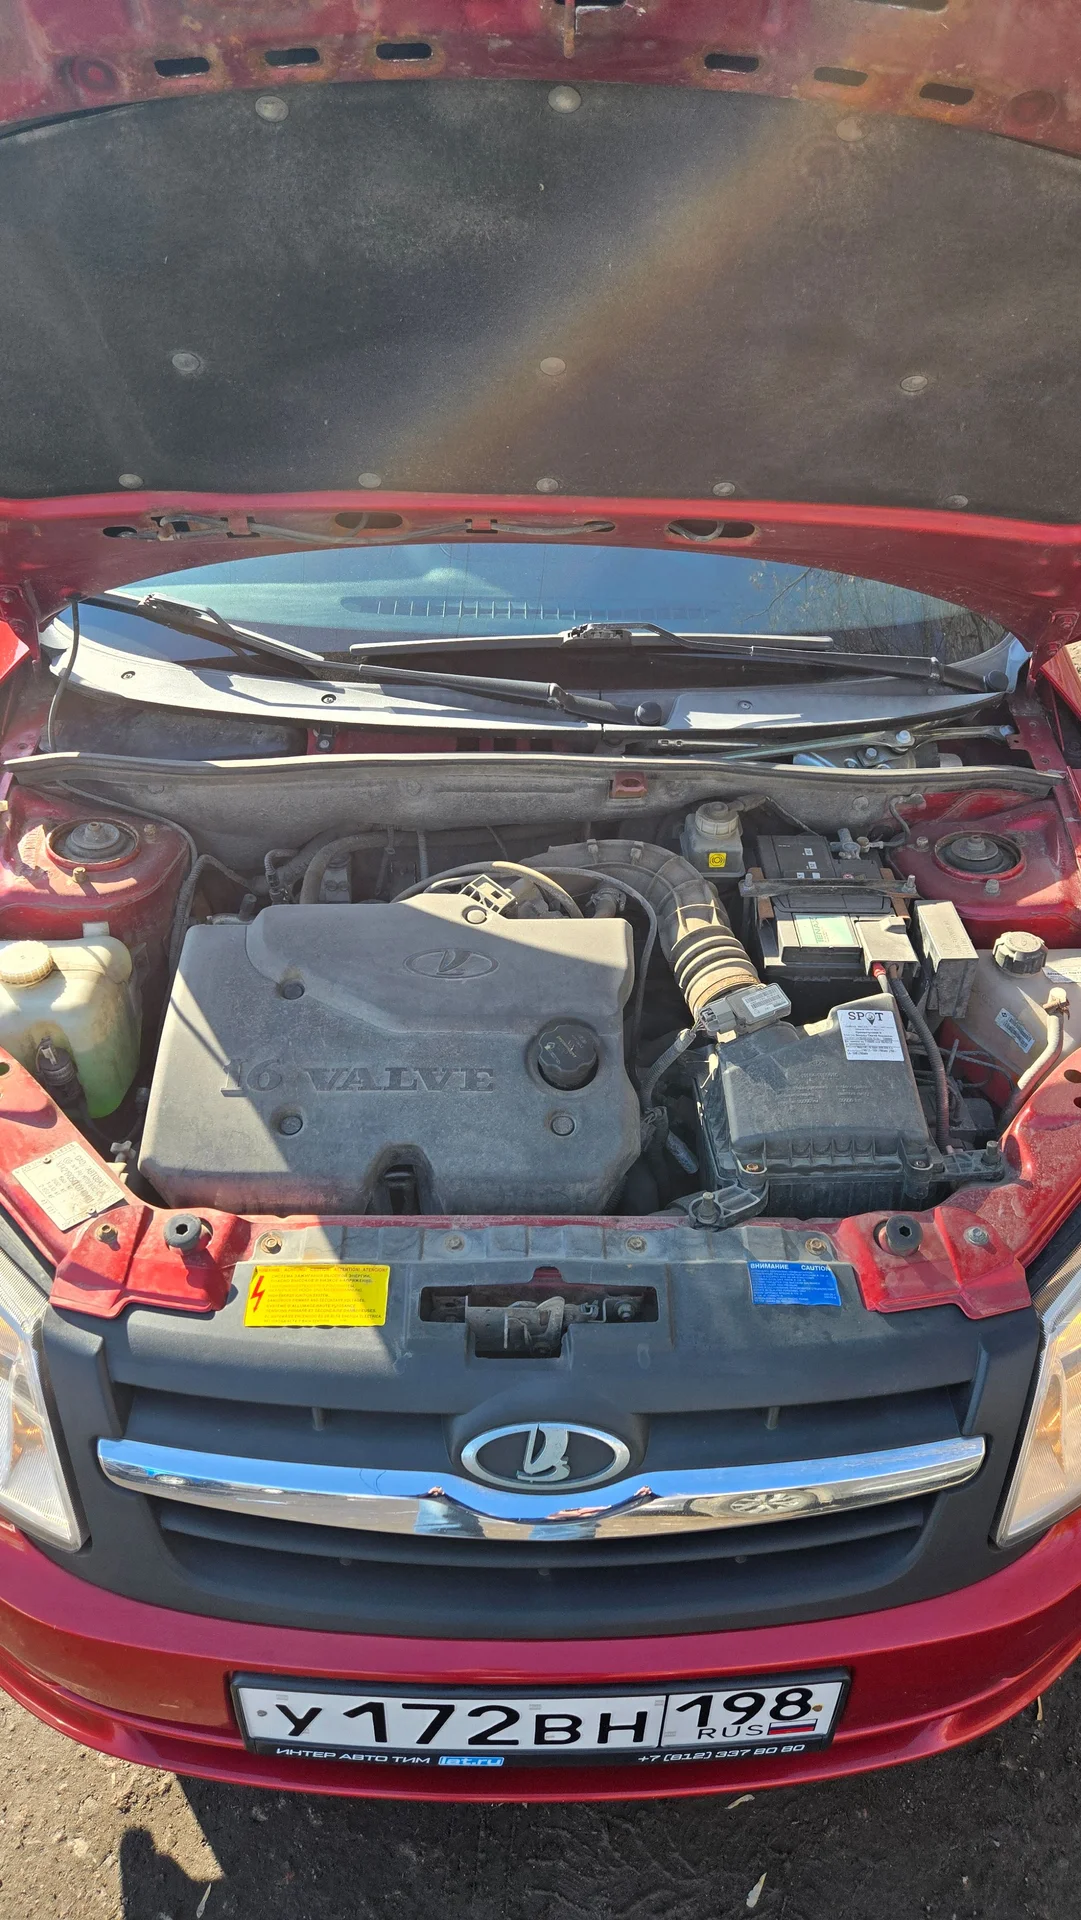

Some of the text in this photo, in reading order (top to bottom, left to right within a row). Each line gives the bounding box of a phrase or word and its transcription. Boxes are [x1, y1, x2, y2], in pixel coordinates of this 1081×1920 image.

[221, 1059, 495, 1097] 16 VALVE
[676, 1687, 813, 1727] 198
[697, 1724, 764, 1740] RUS
[276, 1748, 431, 1765] ИНТЕР АВТО ТИМ
[637, 1744, 806, 1763] +7 (812) 337 80 80
